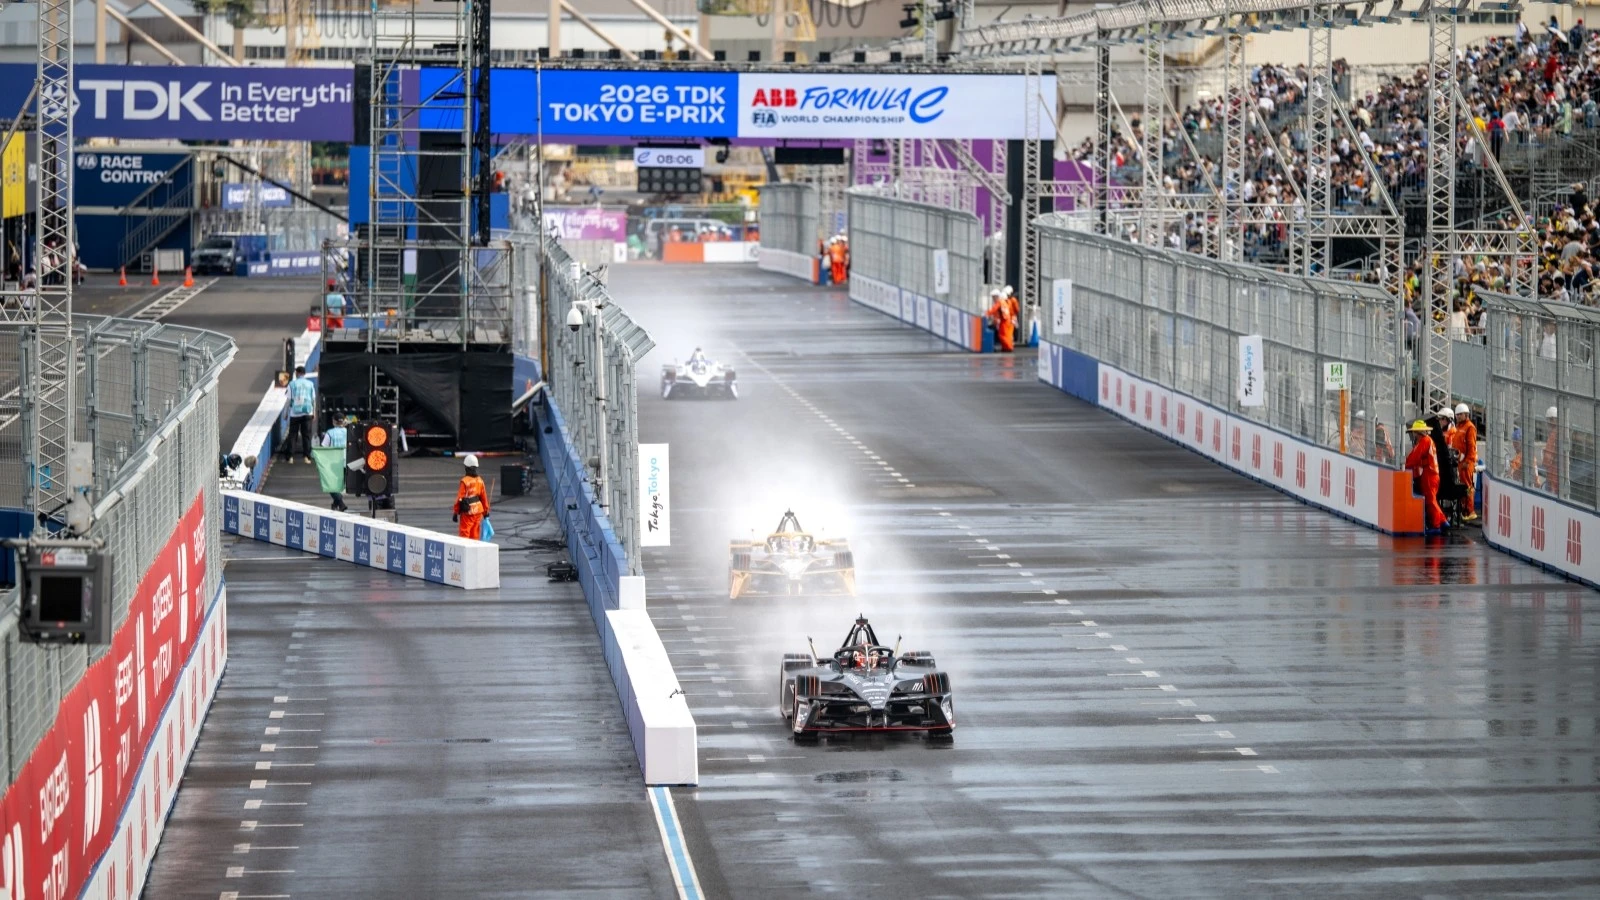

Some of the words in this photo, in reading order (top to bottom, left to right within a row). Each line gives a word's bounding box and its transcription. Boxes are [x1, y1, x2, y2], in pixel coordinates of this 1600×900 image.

[79, 80, 212, 121] TDK
[221, 82, 242, 101] In
[600, 85, 669, 103] 2026
[675, 86, 726, 104] TDK
[752, 88, 798, 108] ABB
[800, 86, 912, 111] FORMULA
[221, 103, 300, 122] Better
[549, 103, 634, 122] TOKYO
[640, 105, 725, 123] E-PRIX
[753, 114, 775, 124] FIA
[781, 115, 819, 124] WORLD
[823, 115, 905, 124] CHAMPIONSHIP
[77, 155, 96, 168] FIA
[101, 155, 142, 169] RACE
[656, 154, 694, 165] 08:06
[648, 457, 660, 495] Tokyo
[1296, 450, 1305, 489] ABB
[1320, 458, 1330, 497] ABB
[1345, 466, 1355, 507] ABB
[648, 495, 663, 532] Tokyo
[1498, 493, 1511, 538] ABB
[1531, 505, 1545, 552] ABB
[1566, 517, 1581, 566] ABB
